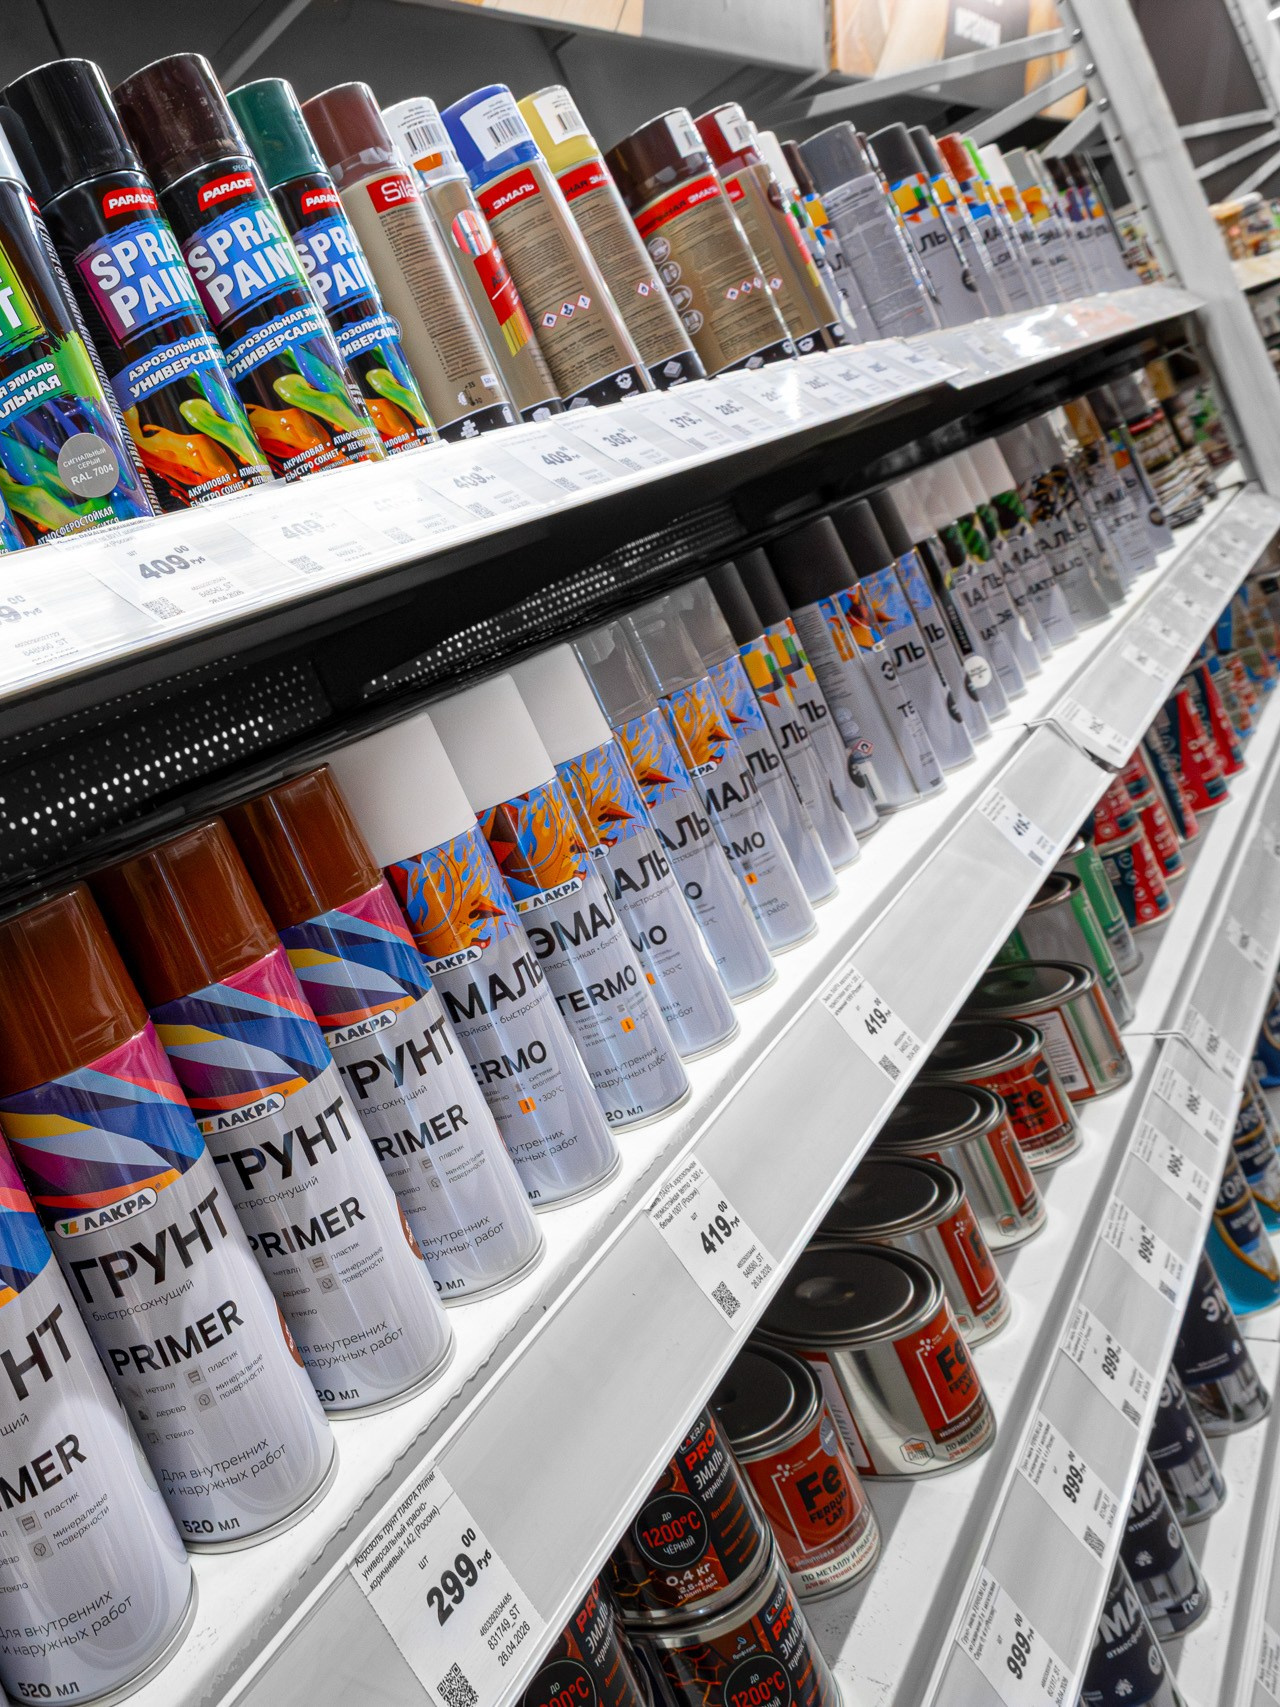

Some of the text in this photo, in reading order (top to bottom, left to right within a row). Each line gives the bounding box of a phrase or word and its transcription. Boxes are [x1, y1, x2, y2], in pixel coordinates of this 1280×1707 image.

[109, 193, 155, 208] PARADE
[202, 177, 253, 202] PARADE
[493, 182, 535, 210] ЭМАЛЬ
[8, 361, 55, 388] ЭМАЛЬ
[72, 464, 114, 485] RAL 7004
[283, 443, 324, 470] АКРИЛОВАЯ
[188, 475, 231, 498] АКРИЛОВАЯ
[139, 553, 190, 581] 409
[532, 879, 579, 907] ЛАКРА
[443, 952, 544, 1025] МАЛЬ
[554, 965, 637, 1017] TERMO
[334, 1014, 392, 1047] ЛАКРА
[864, 1008, 887, 1035] 419
[469, 1040, 547, 1085] ERMO
[218, 1098, 279, 1129] ЛАКРА
[626, 1104, 644, 1118] мл
[372, 1104, 469, 1162] RIMER
[84, 1194, 151, 1232] ЛАКРА
[248, 1198, 366, 1259] PRIMER
[700, 1200, 732, 1255] 419 00
[730, 1216, 740, 1228] Руб
[69, 1188, 230, 1304] ГРУНТ
[422, 1216, 490, 1248] внутренних
[475, 1222, 505, 1244] работ
[92, 1279, 195, 1322] быстросохнущий
[446, 1278, 466, 1289] мл
[108, 1300, 245, 1376] PRIMER
[319, 1320, 388, 1353] внутренних
[370, 1326, 404, 1353] работ
[145, 1351, 239, 1395] металл пластик
[216, 1353, 264, 1390] минеральные
[155, 1364, 265, 1420] дерево поверхности
[339, 1387, 359, 1401] мл
[165, 1428, 195, 1440] стекло
[162, 1438, 269, 1484] Для внутренних
[178, 1442, 287, 1498] наружных работ
[693, 1449, 723, 1490] ЭМАЛЬ
[796, 1465, 843, 1511] Fe
[1062, 1465, 1082, 1503] 999
[43, 1491, 80, 1519] пластик
[52, 1493, 109, 1540] минеральные
[354, 1472, 436, 1568] Аэрозоль грунт ЛАКРА Primer
[662, 1512, 671, 1521] до
[56, 1506, 111, 1549] поверхности
[182, 1517, 240, 1534] 520 мл
[362, 1501, 427, 1581] универсальный красно-
[642, 1511, 701, 1548] 1200°C
[370, 1506, 441, 1591] коричневый 142 (Россия)
[418, 1555, 429, 1570] шт
[476, 1549, 492, 1570] Руб
[427, 1528, 479, 1626] 299 00
[665, 1563, 711, 1587] 0,4 кг
[802, 1573, 814, 1582] ПО
[13, 1596, 134, 1658] наружных работ
[25, 1591, 114, 1640] внутренних
[487, 1604, 522, 1651] 831749_ST
[585, 1599, 608, 1654] ЭМАЛЬ
[497, 1620, 531, 1667] 26.04.2026
[1007, 1631, 1031, 1679] 999
[18, 1682, 51, 1698] 520
[57, 1681, 80, 1696] мл
